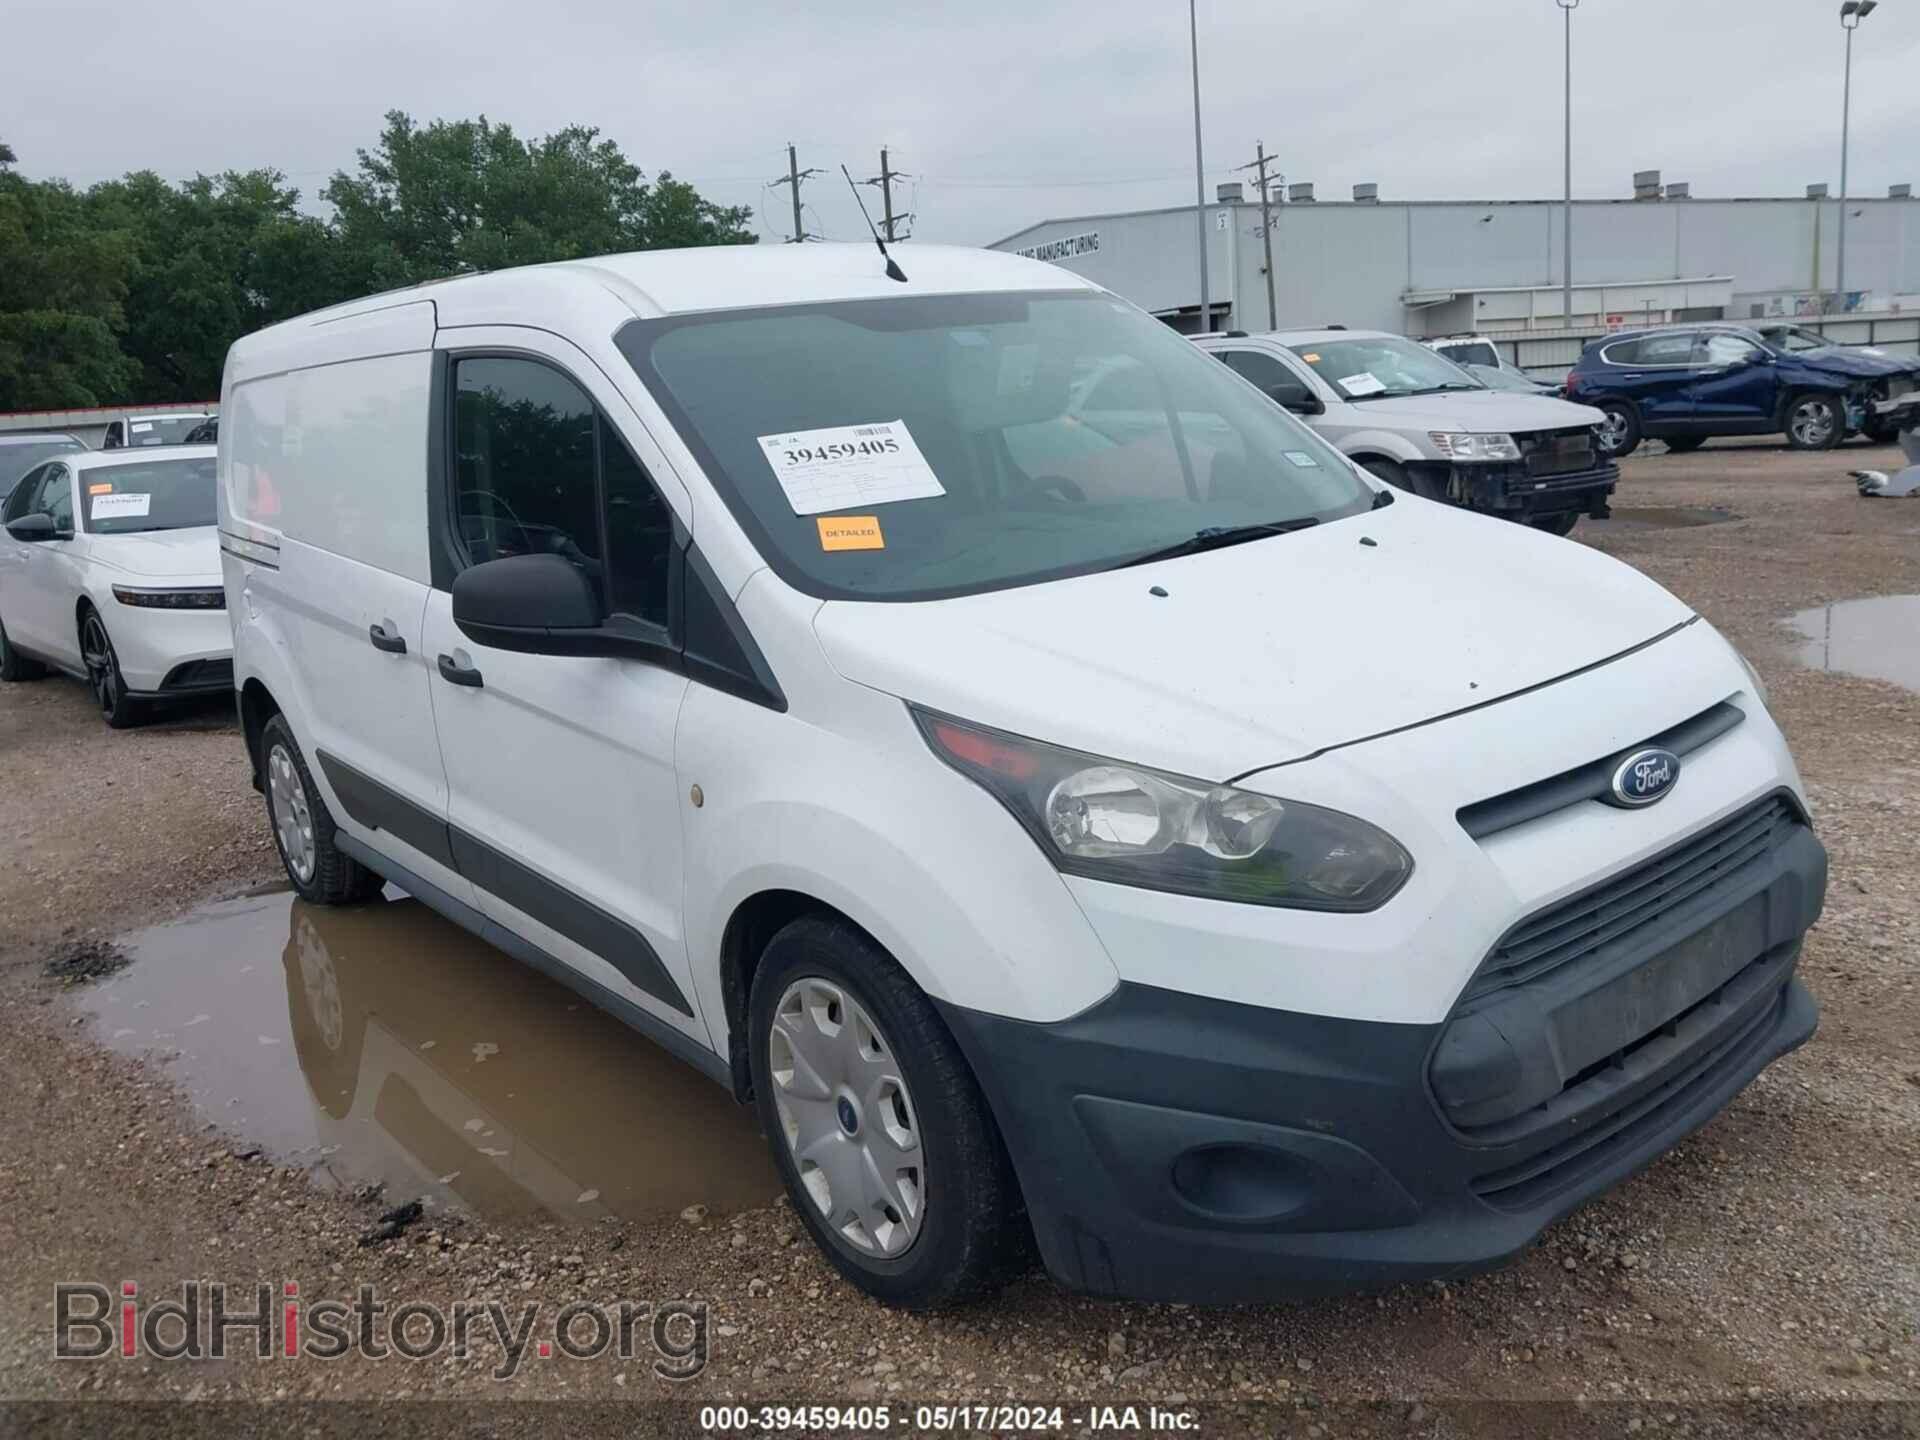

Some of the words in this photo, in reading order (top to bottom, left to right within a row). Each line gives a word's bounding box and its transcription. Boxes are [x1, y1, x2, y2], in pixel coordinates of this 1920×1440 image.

[1036, 232, 1098, 261] MANUFACTURING
[783, 438, 900, 466] 39459405
[825, 528, 875, 537] DETAILED
[1635, 757, 1671, 793] Ford
